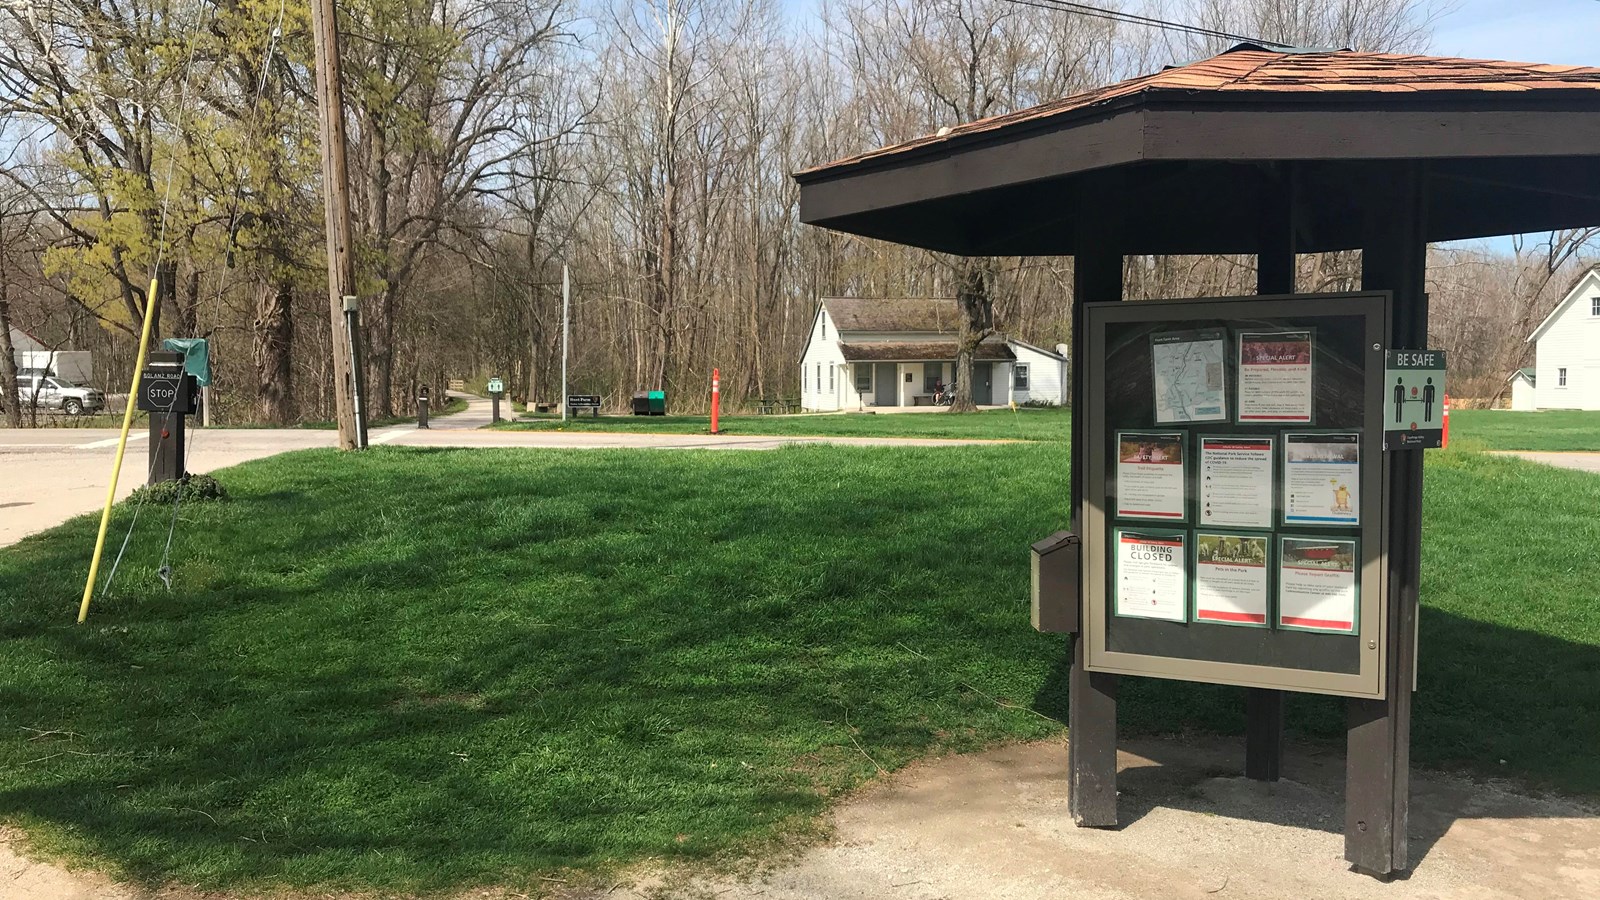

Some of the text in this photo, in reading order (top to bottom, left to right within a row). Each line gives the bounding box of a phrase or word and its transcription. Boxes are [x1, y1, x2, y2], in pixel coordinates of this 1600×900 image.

[1397, 353, 1435, 367] BE SAFE
[150, 388, 174, 398] STOP
[1130, 544, 1172, 554] BUILDING
[1130, 552, 1172, 562] CLOSED
